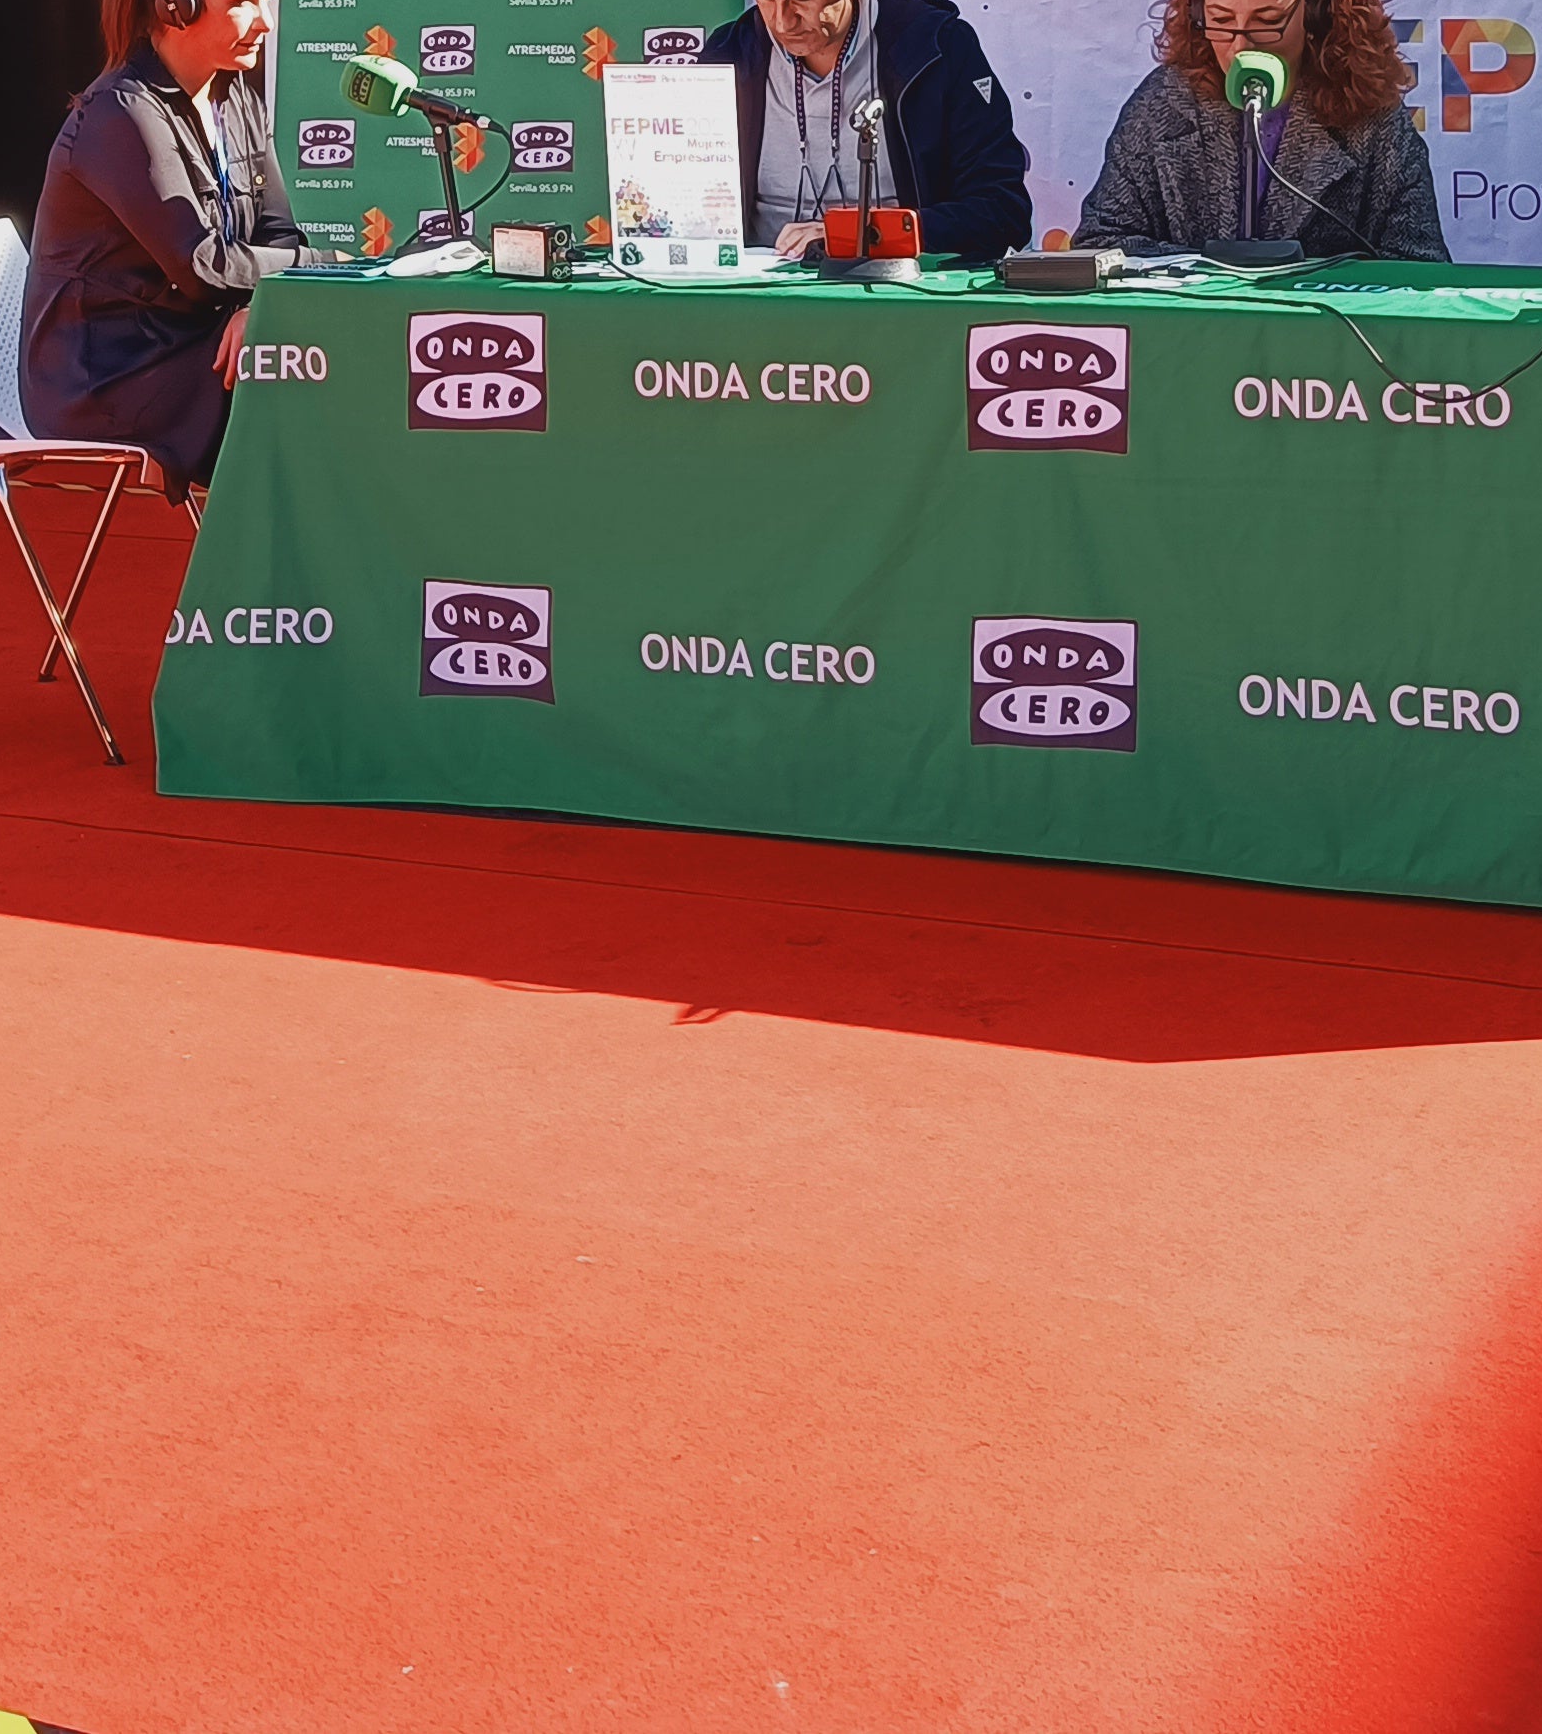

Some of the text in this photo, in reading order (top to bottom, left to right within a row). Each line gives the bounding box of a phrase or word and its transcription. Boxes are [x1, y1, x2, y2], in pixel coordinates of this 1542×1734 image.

[508, 44, 575, 56] ATRESMEDIA
[548, 56, 576, 65] RADIO
[305, 129, 347, 142] ONDA
[519, 131, 564, 144] ONDA
[610, 117, 685, 136] FEPME
[308, 149, 347, 162] CERO
[522, 152, 564, 164] CERO
[510, 184, 573, 194] Sevilla 95.9 FM
[426, 336, 524, 360] ONDA
[990, 349, 1102, 375] ONDA
[634, 360, 870, 403] ONDA CERO
[433, 382, 525, 409] CERO
[1234, 377, 1513, 429] ONDA CERO
[996, 398, 1103, 429] CERO
[165, 607, 333, 645] DA CERO
[443, 599, 533, 633] ONDA
[449, 644, 537, 680] CERO
[641, 633, 875, 684] ONDA CERO
[993, 643, 1110, 671] ONDA
[1000, 693, 1110, 726] CERO
[1239, 674, 1520, 734] ONDA CERO
